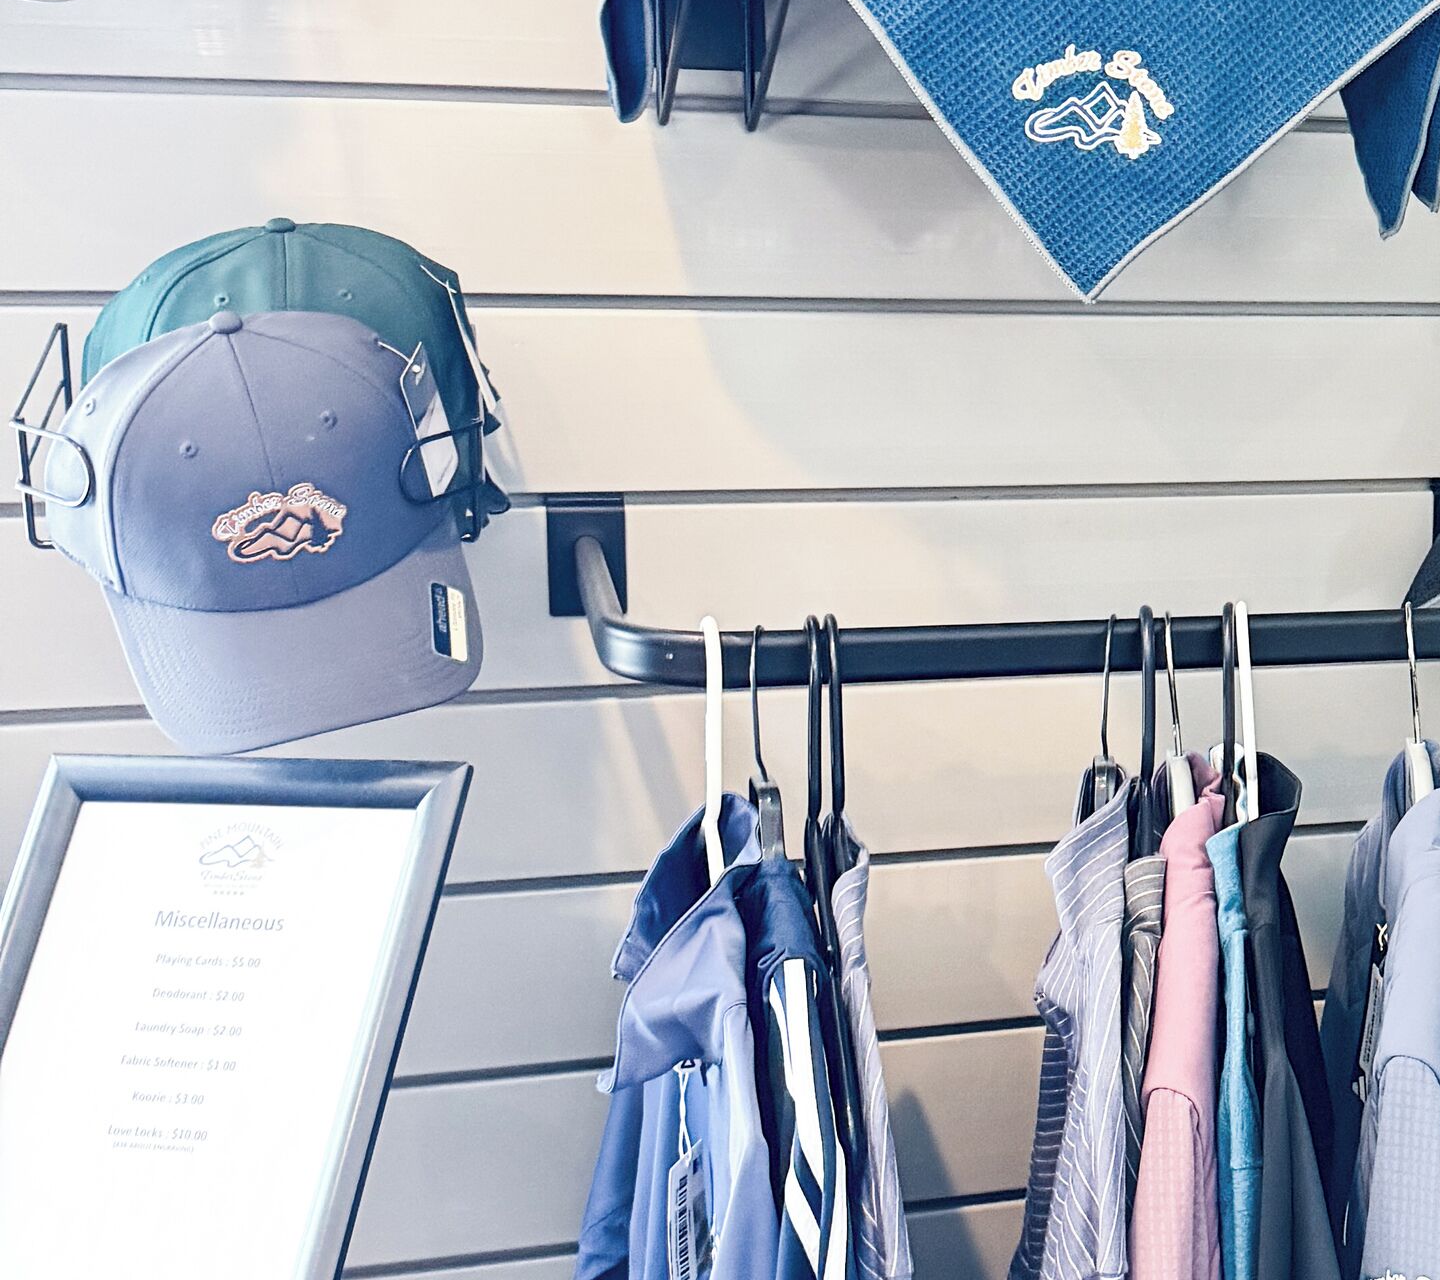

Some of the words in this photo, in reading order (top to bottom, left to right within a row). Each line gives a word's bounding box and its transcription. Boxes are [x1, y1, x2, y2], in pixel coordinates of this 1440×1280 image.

[226, 821, 285, 851] MOUNTAIN
[154, 909, 285, 932] Miscellaneous
[155, 953, 193, 968] Playing
[195, 955, 223, 967] Cards
[231, 956, 262, 968] $5.00
[152, 986, 208, 1000] Deodorant
[215, 989, 245, 1002] $2.00
[134, 1020, 177, 1036] Laundry
[178, 1023, 205, 1037] Soap
[212, 1024, 243, 1037] $2.00
[120, 1054, 152, 1067] Fabric
[152, 1056, 199, 1069] Softener
[206, 1058, 237, 1072] $1.00
[131, 1090, 167, 1103] Koozie
[174, 1092, 205, 1105] $3.00
[107, 1124, 133, 1137] Love
[134, 1125, 163, 1139] Locks
[171, 1127, 208, 1142] $10.00
